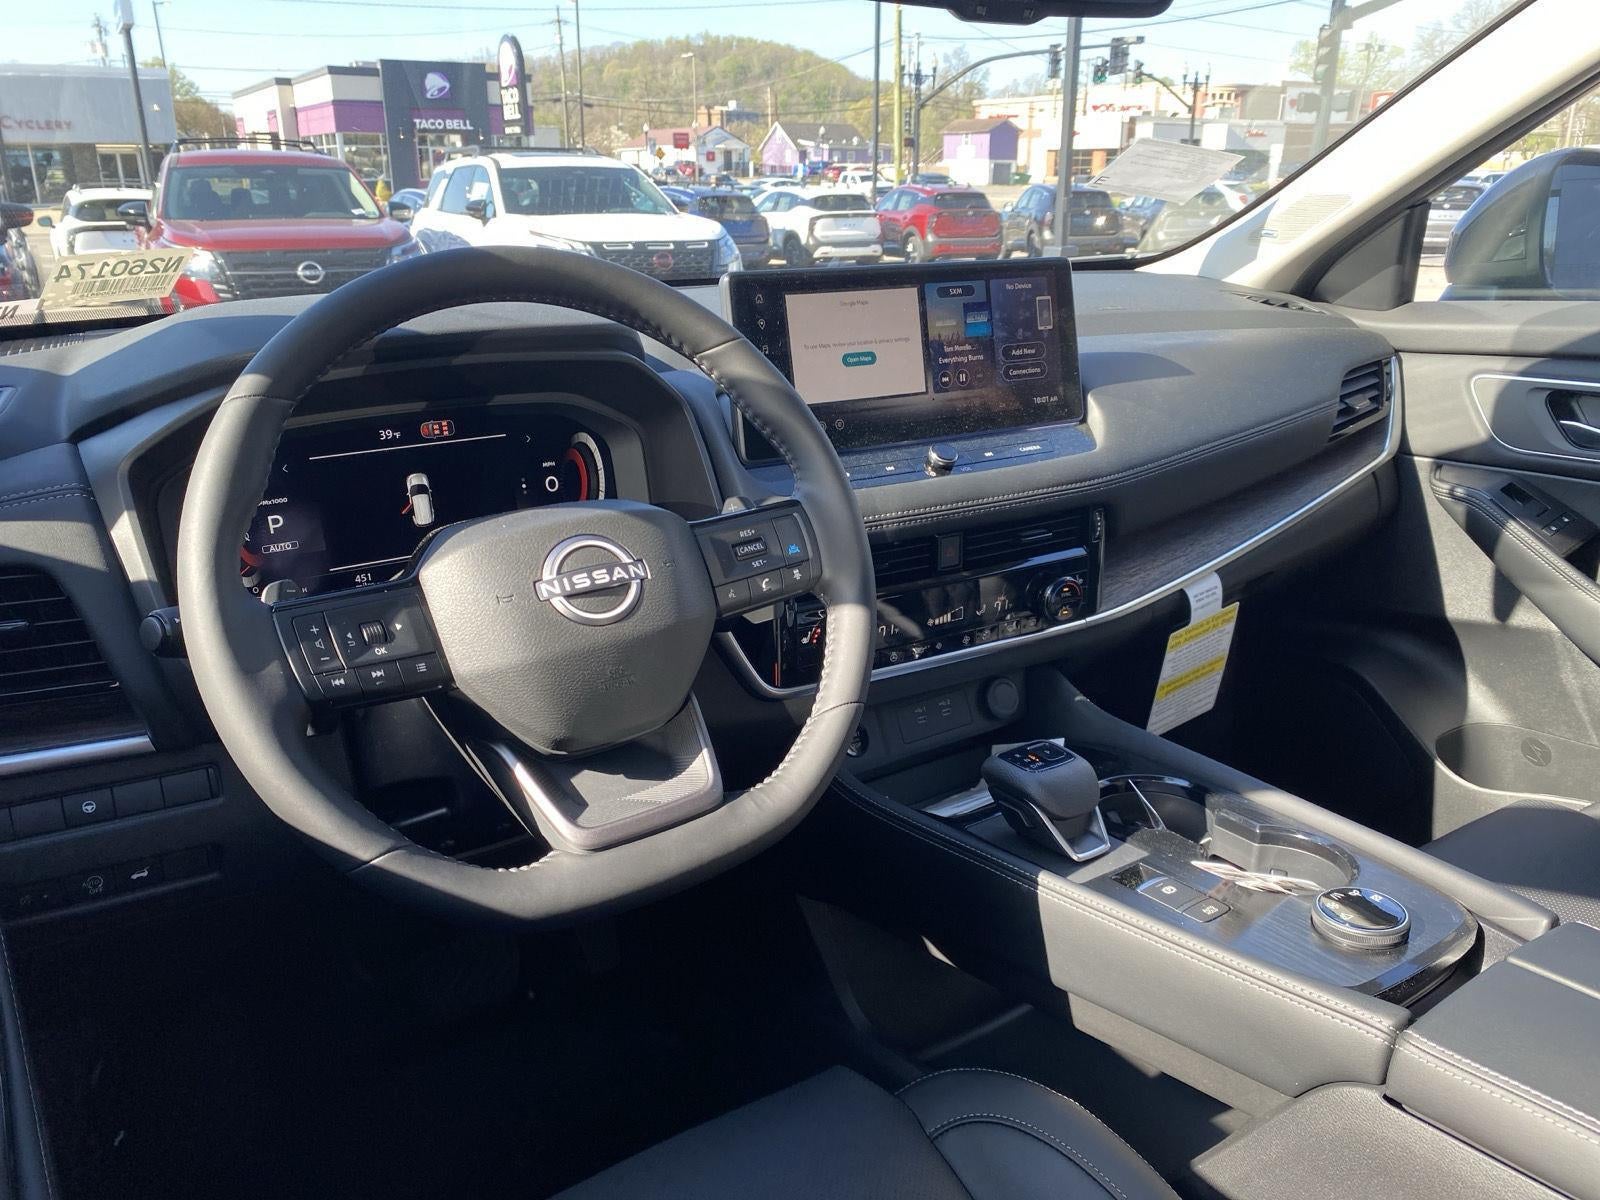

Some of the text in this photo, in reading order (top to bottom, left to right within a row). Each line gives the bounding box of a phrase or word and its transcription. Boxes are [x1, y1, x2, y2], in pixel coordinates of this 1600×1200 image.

[413, 118, 474, 130] TACO BELL
[1015, 281, 1032, 289] Device
[938, 355, 968, 365] Everything
[1009, 366, 1041, 376] Connections
[1019, 444, 1042, 452] CAMERA
[258, 497, 288, 506] Mx1000
[267, 514, 284, 535] P
[740, 529, 756, 538] RES+
[269, 542, 292, 553] AUTO
[739, 543, 765, 554] CANCEL
[355, 572, 372, 583] 451
[539, 563, 645, 598] NISSAN
[374, 647, 388, 655] OK
